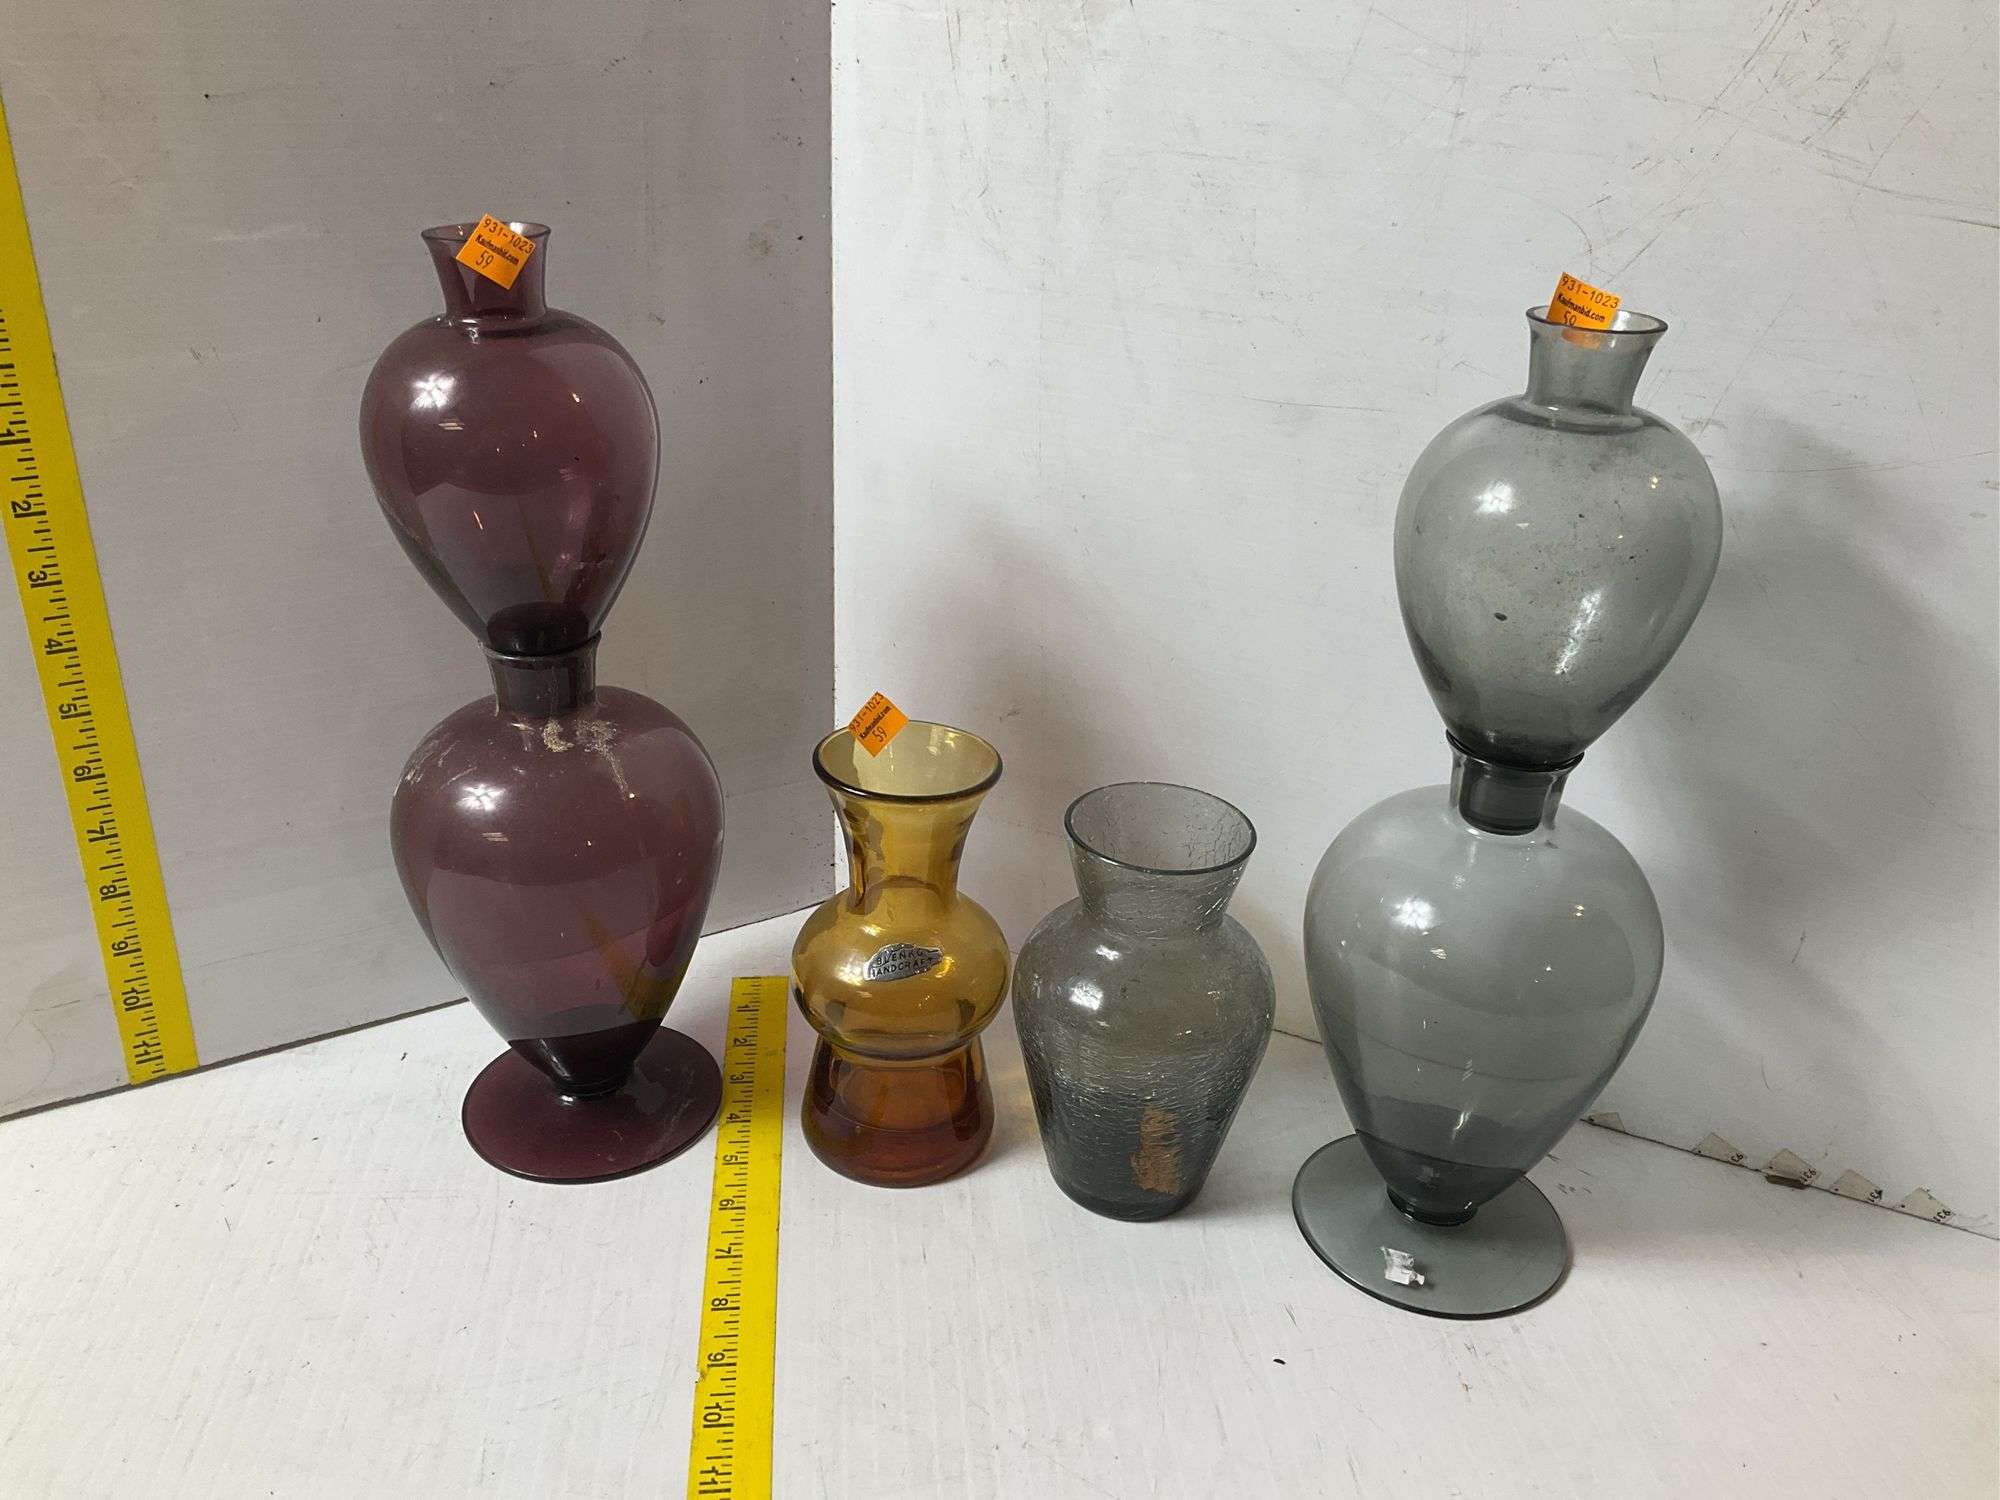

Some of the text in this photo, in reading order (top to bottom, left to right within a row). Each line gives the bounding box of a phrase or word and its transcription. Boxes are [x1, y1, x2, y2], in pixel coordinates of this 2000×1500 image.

[483, 218, 534, 254] 931-1023
[475, 250, 494, 269] 59
[1560, 276, 1619, 309] 931-1023
[1557, 293, 1605, 322] Kaufmanbid.com
[11, 500, 31, 513] 2
[28, 570, 47, 582] 3
[44, 638, 63, 650] 4
[59, 704, 78, 714] 5
[872, 726, 887, 742] 59
[73, 766, 91, 778] 6
[86, 825, 105, 837] 7
[100, 885, 117, 897] 8
[112, 941, 129, 952] 9
[122, 988, 140, 1007] 10
[132, 1040, 149, 1059] 11
[730, 1074, 744, 1082] 3
[719, 1199, 735, 1207] 6
[715, 1246, 731, 1255] 7
[711, 1297, 728, 1307] 8
[707, 1352, 725, 1363] 9
[703, 1402, 722, 1424] 10
[699, 1466, 718, 1487] 11
